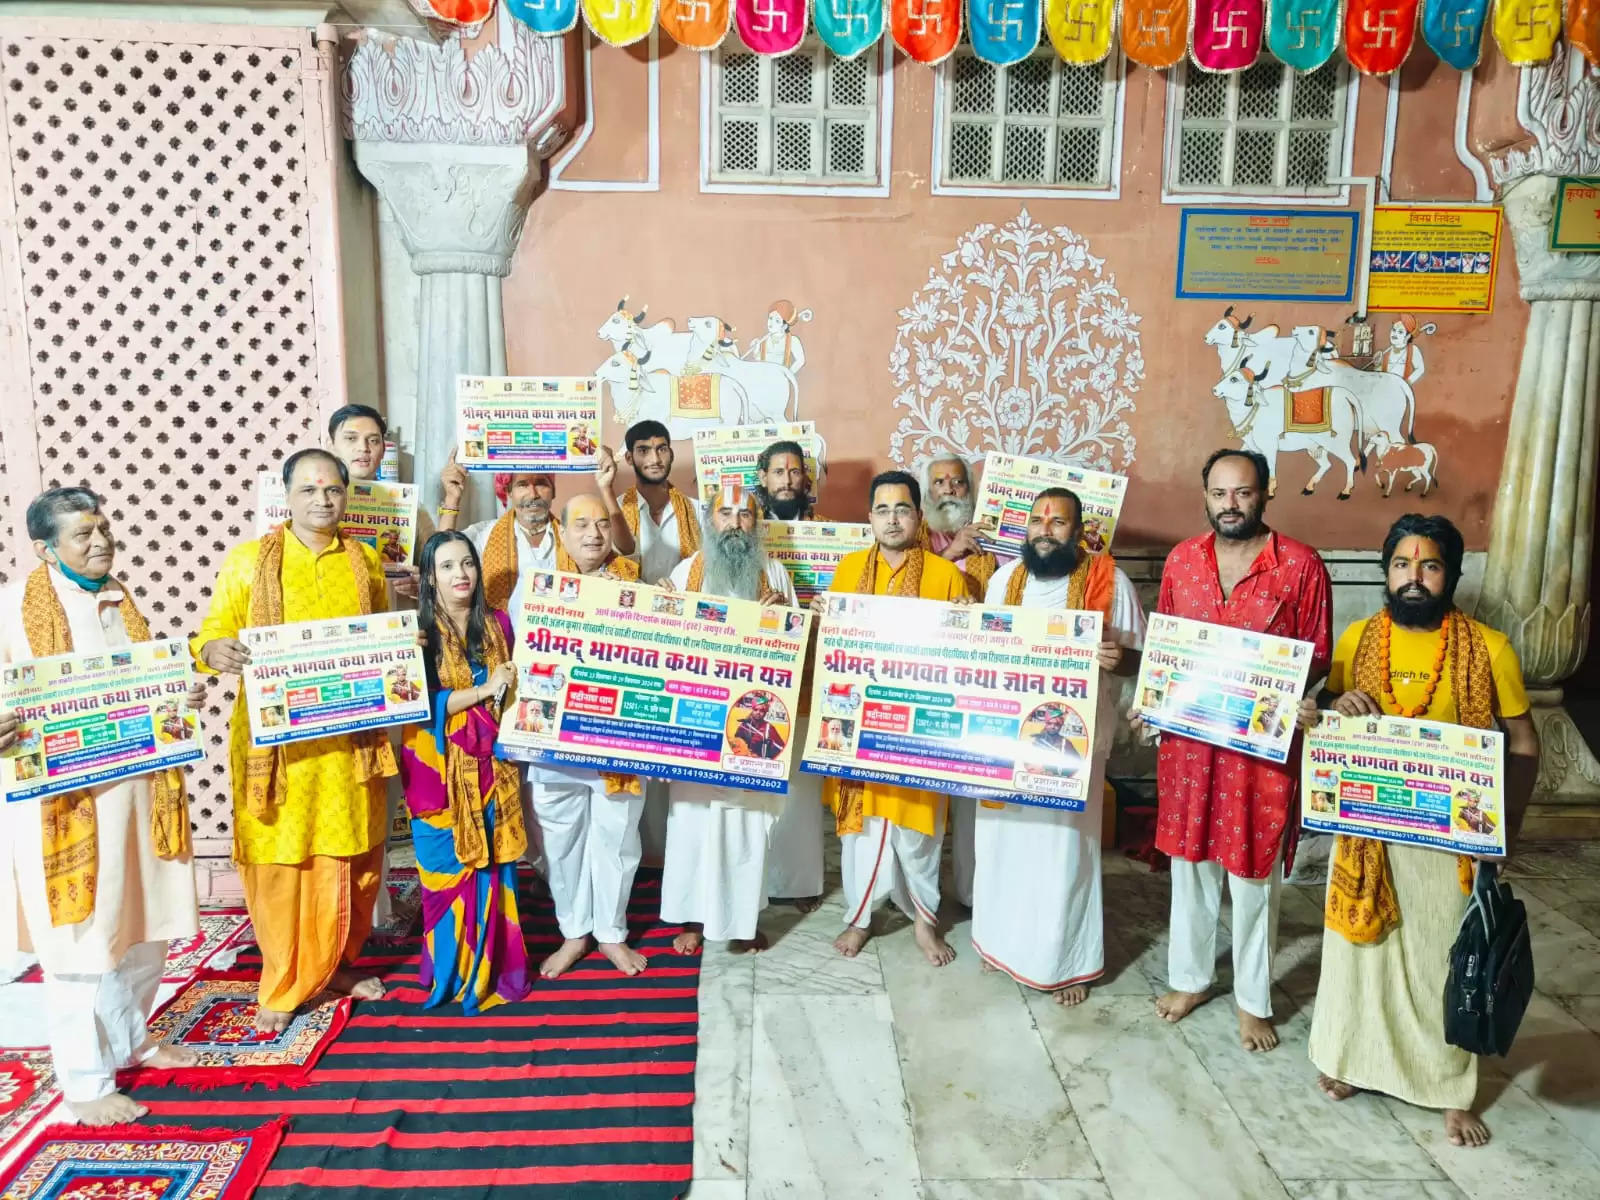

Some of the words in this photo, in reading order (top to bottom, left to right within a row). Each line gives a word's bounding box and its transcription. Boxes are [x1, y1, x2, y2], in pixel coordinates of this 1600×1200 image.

[463, 406, 492, 421] श्रीमद्
[494, 409, 529, 419] भागवत
[532, 409, 553, 419] कथा
[557, 409, 577, 419] ज्ञान
[580, 409, 596, 419] यज्ञ
[726, 453, 754, 464] भागवत
[986, 482, 1013, 500] श्रीमद्
[367, 514, 388, 526] ज्ञान
[391, 515, 409, 526] यज्ञ
[776, 551, 808, 562] भागवत
[810, 551, 829, 562] कथा
[764, 637, 800, 651] बद्रीनाथ
[252, 662, 291, 682] श्रीमद्
[292, 657, 336, 674] भागवत
[338, 654, 364, 668] कथा
[368, 650, 392, 664] ज्ञान
[395, 647, 415, 660] यज्ञ
[524, 627, 586, 664] श्रीमद्
[588, 640, 661, 668] भागवत
[663, 651, 709, 675] कथा
[712, 658, 755, 683] ज्ञान
[757, 665, 793, 688] यज्ञ
[1147, 647, 1179, 669] श्रीमद्
[1249, 672, 1272, 688] ज्ञान
[822, 647, 880, 682] श्रीमद्
[880, 658, 949, 684] भागवत
[951, 666, 997, 689] कथा
[1001, 671, 1046, 694] ज्ञान
[1049, 675, 1089, 699] यज्ञ
[50, 694, 99, 717] भागवत
[102, 688, 131, 706] कथा
[133, 683, 161, 700] ज्ञान
[165, 679, 187, 694] यज्ञ
[552, 752, 610, 767] 8890889988,
[611, 759, 669, 774] 8947836717,
[670, 766, 727, 782] 9314193547,
[729, 774, 781, 788] 9950292602
[1310, 747, 1349, 768] श्रीमद्
[1351, 754, 1398, 771] भागवत
[1402, 760, 1433, 776] कथा
[1438, 765, 1465, 782] ज्ञान
[1469, 771, 1493, 788] यज्ञ
[1021, 793, 1078, 808] 9950292602
